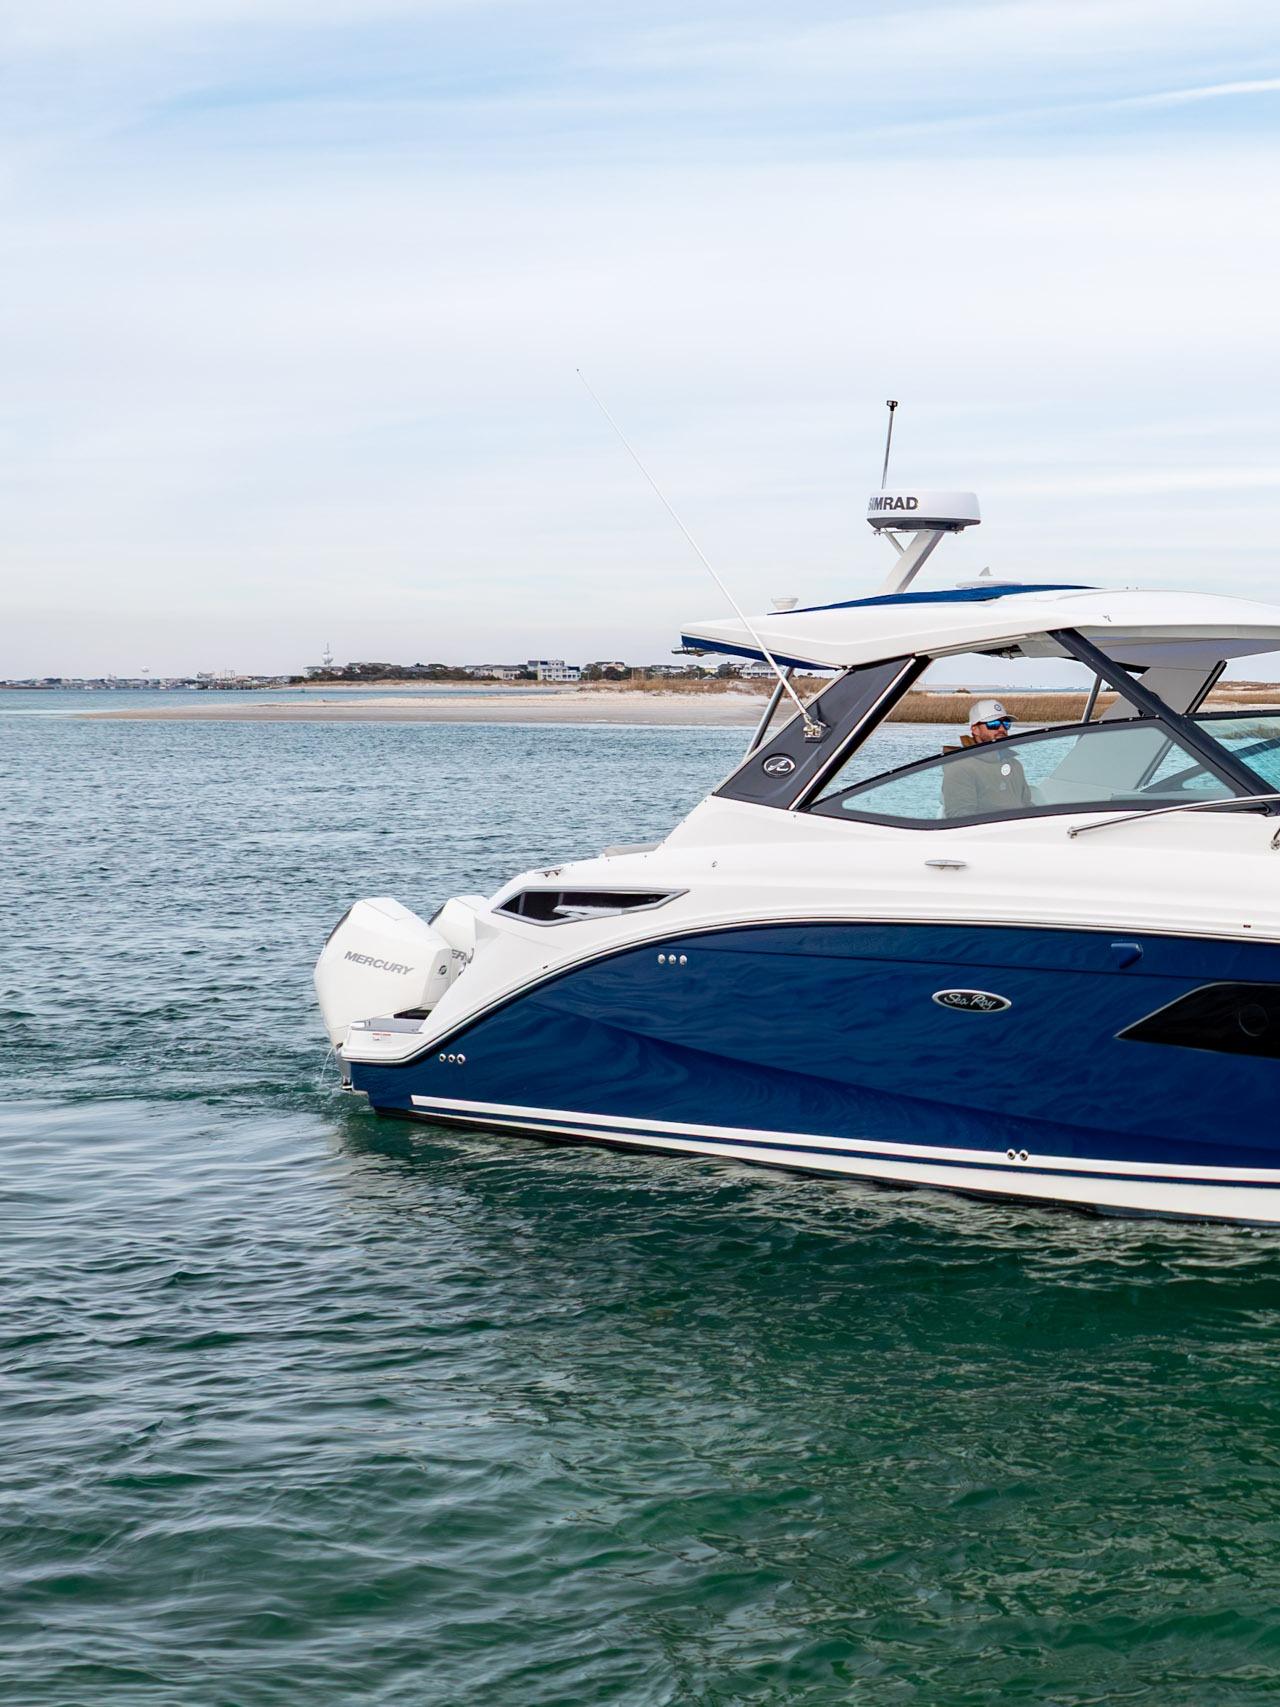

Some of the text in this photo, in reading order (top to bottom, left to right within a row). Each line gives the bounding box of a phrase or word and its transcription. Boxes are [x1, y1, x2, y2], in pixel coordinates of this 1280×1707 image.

[868, 496, 918, 510] SIMRAD
[344, 951, 415, 975] MERCURY
[943, 993, 996, 1010] Sea Ray
